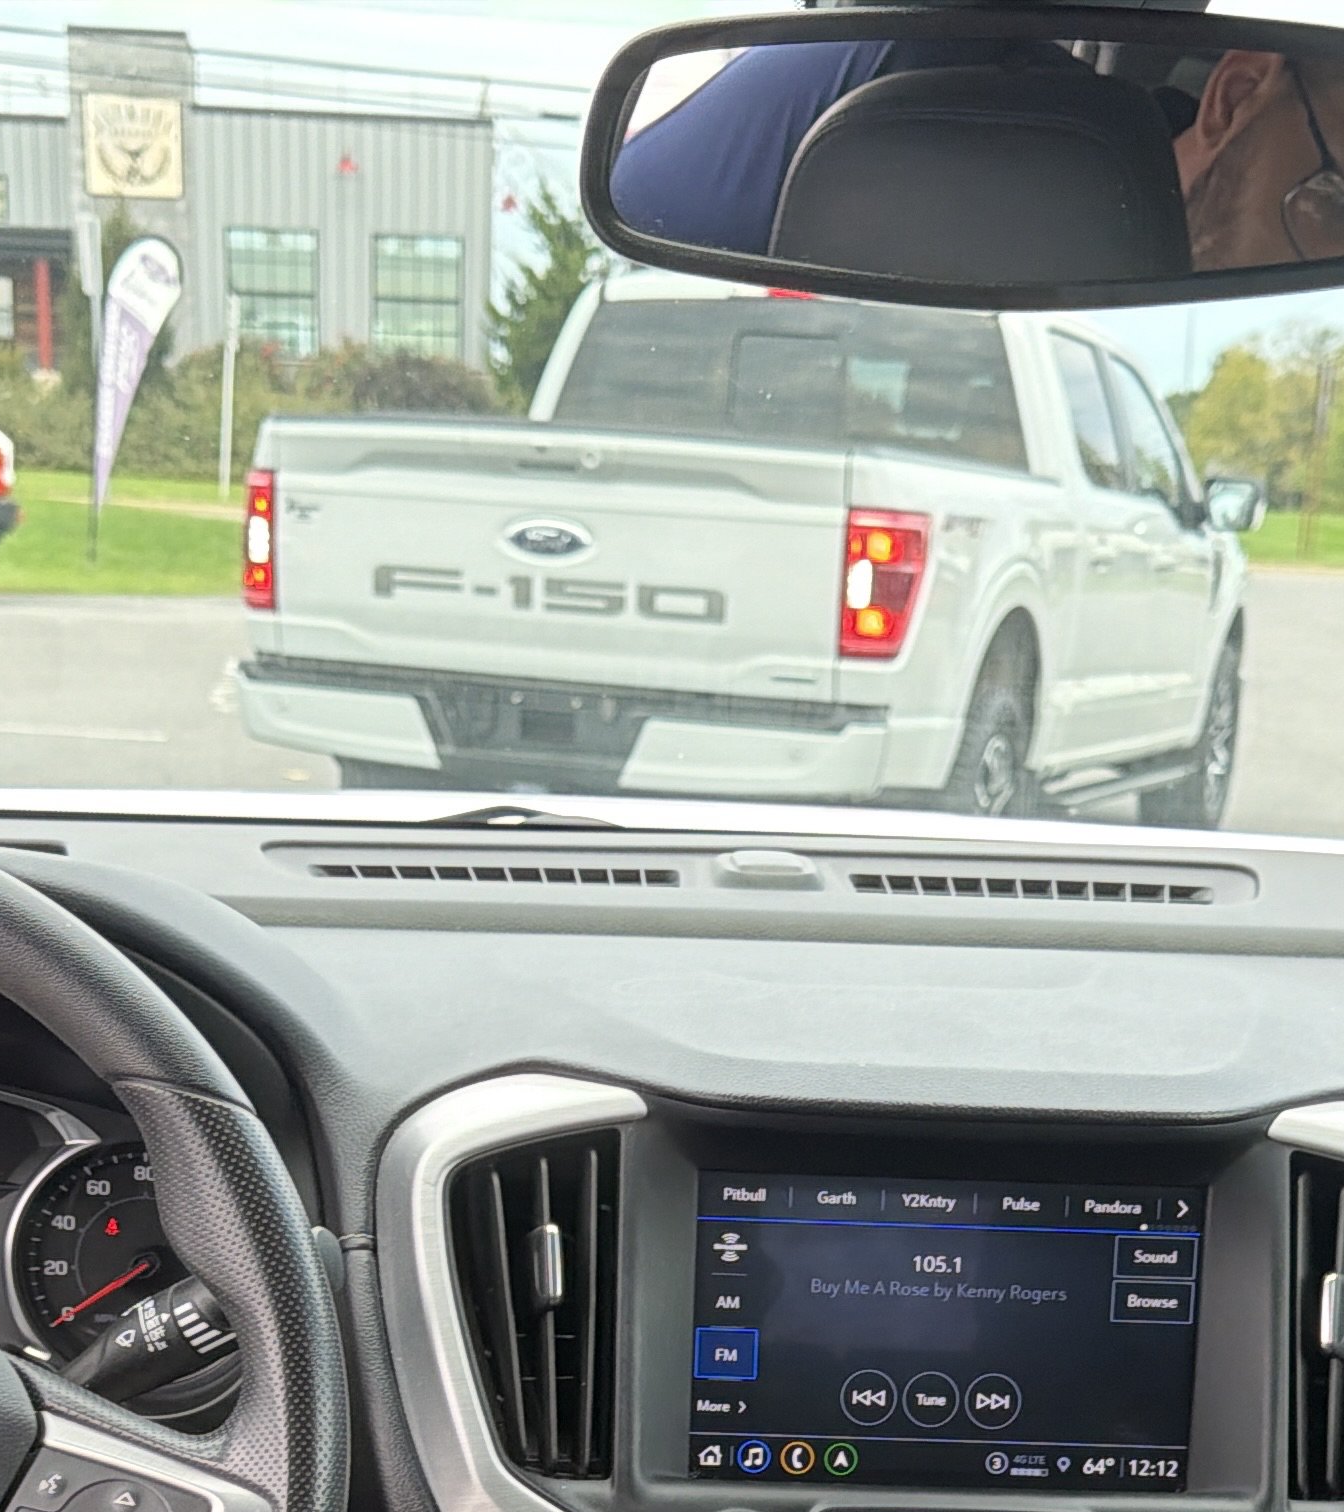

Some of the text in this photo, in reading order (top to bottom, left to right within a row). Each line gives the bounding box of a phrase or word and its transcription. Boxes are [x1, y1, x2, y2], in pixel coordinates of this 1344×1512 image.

[373, 565, 726, 625] F-150
[134, 1165, 156, 1182] 80
[86, 1179, 111, 1196] 60
[723, 1187, 767, 1202] Pitbull
[816, 1190, 857, 1205] Garth
[902, 1194, 957, 1213] Y2Kntry
[1002, 1196, 1041, 1212] Pulse
[1084, 1199, 1143, 1215] Pandora
[51, 1215, 76, 1231] 40
[912, 1255, 962, 1274] 105.1
[1133, 1249, 1178, 1265] Sound
[43, 1260, 68, 1276] 20
[810, 1278, 1068, 1305] Buy Me A Rose by Kenny Rogers
[715, 1296, 741, 1310] AM
[1127, 1293, 1179, 1309] Browse
[714, 1347, 738, 1362] FM
[696, 1399, 731, 1413] More
[914, 1393, 947, 1407] Tune
[1028, 1455, 1047, 1465] LTE
[1082, 1457, 1116, 1475] 64°
[1128, 1459, 1179, 1478] 12:12
